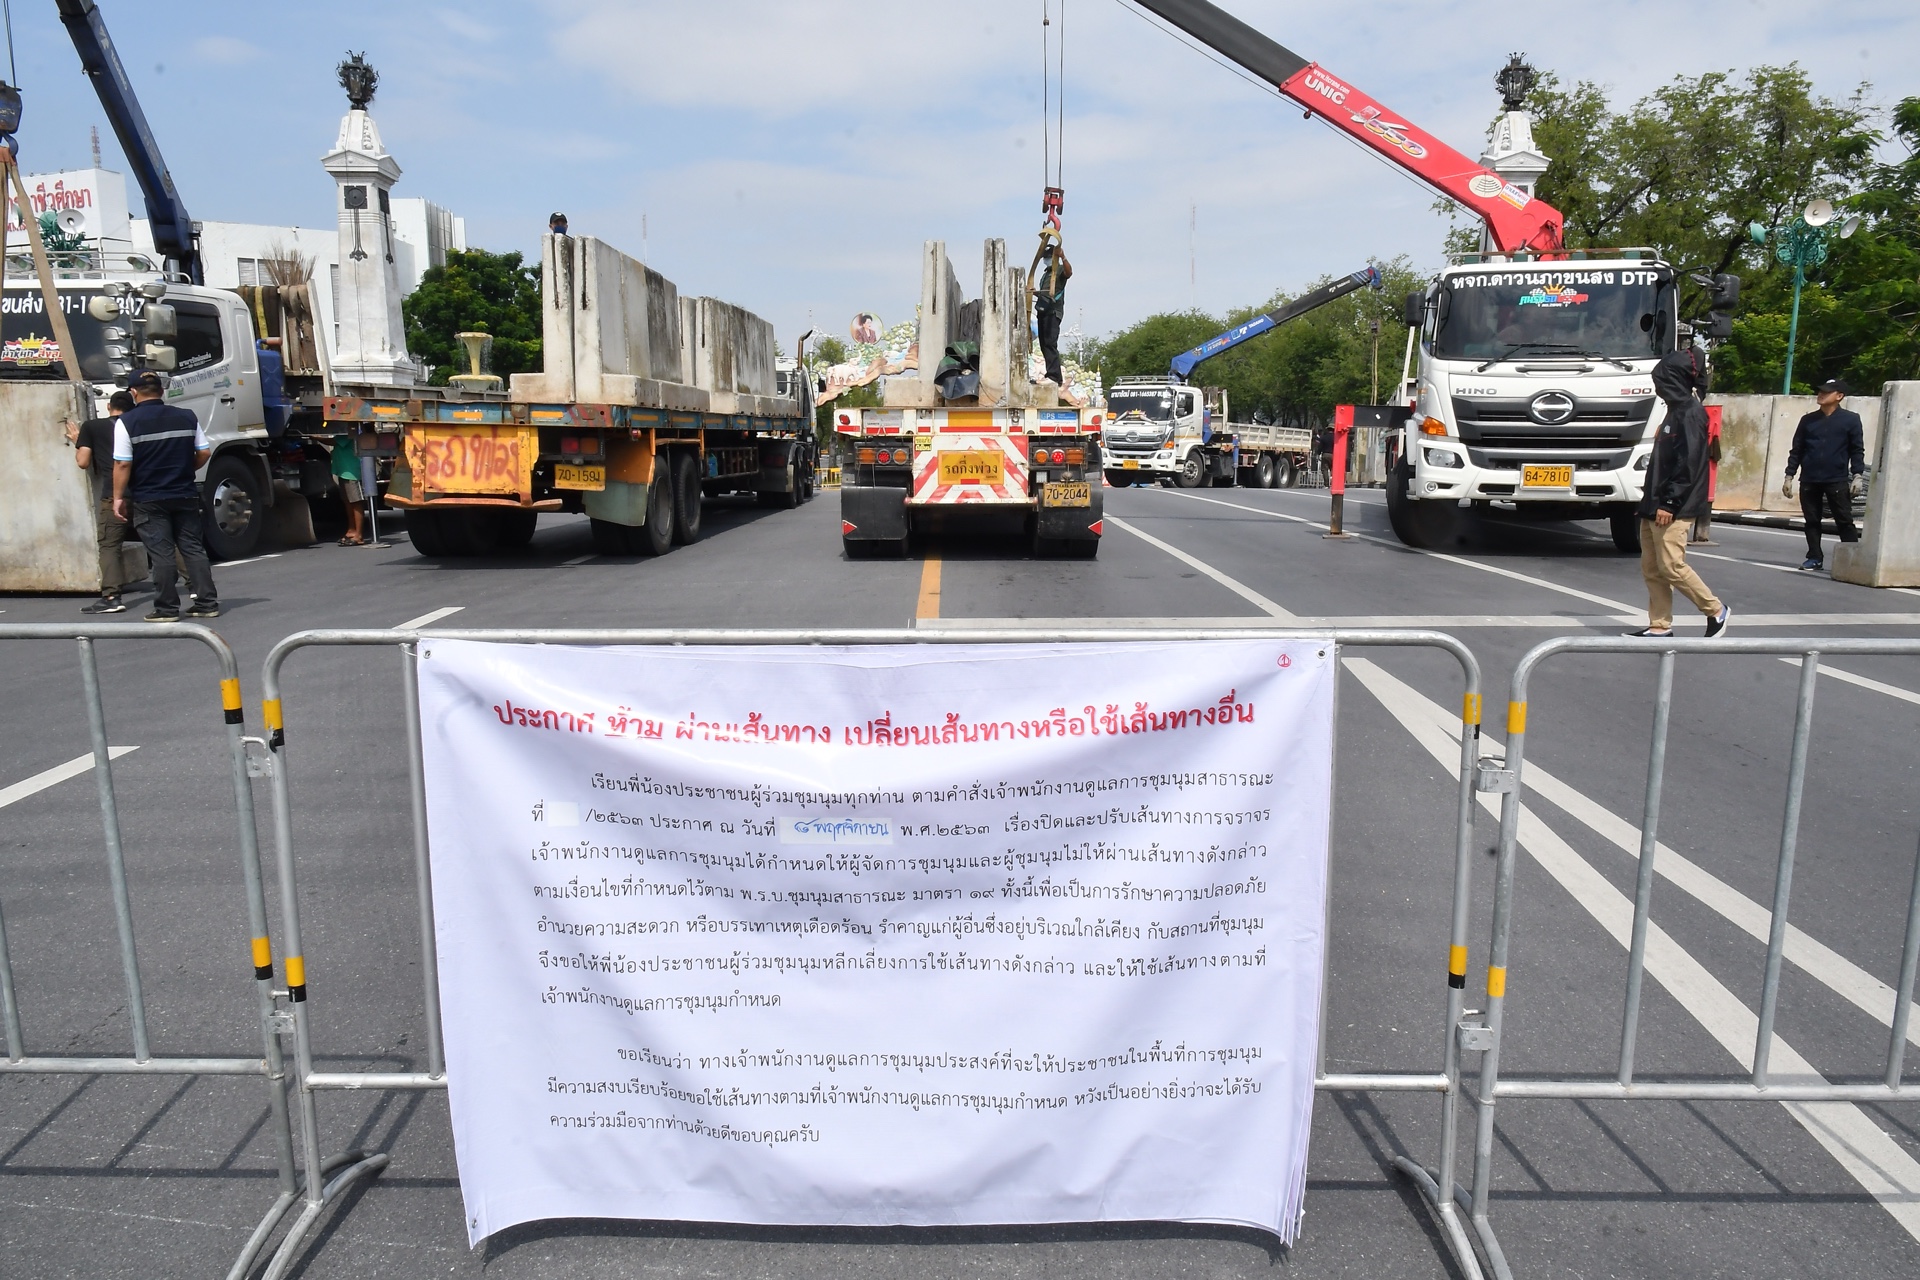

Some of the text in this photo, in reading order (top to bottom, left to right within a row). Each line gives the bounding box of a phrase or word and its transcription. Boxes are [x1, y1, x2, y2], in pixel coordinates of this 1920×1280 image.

[1304, 74, 1346, 105] UNIC
[1621, 272, 1658, 285] DTP
[2, 291, 43, 314] ขนส่ง
[1455, 387, 1497, 395] HINO
[944, 455, 998, 474] รถกึ่งพ่วง
[1525, 470, 1570, 482] 64-7810
[1046, 488, 1089, 500] 70-2044
[844, 688, 1255, 747] เปลี่ยนเส้นทางหรือใช้เส้นทางอื่น
[912, 772, 1274, 803] ตามคำสั่งเจ้าพนักงานดูแลการชุมนุมสาธารณะ
[531, 798, 544, 822] ที่
[649, 813, 713, 832] ประกาศ
[719, 822, 735, 834] ณ
[741, 816, 776, 837] วันที่
[1004, 804, 1271, 833] เรื่องปิดและปรับเส้นทางการจราจร
[912, 888, 962, 901] มาตรา
[537, 914, 679, 937] อำนวยความสะดวก
[685, 914, 873, 939] หรือบรรเทาเหตุเดือดร้อน
[1147, 910, 1264, 940] กับสถานที่ชุมนุม
[541, 985, 781, 1016] เจ้าพนักงานดูแลการชุมนุมกำหนด
[617, 1047, 691, 1070] ขอเรียนว่า
